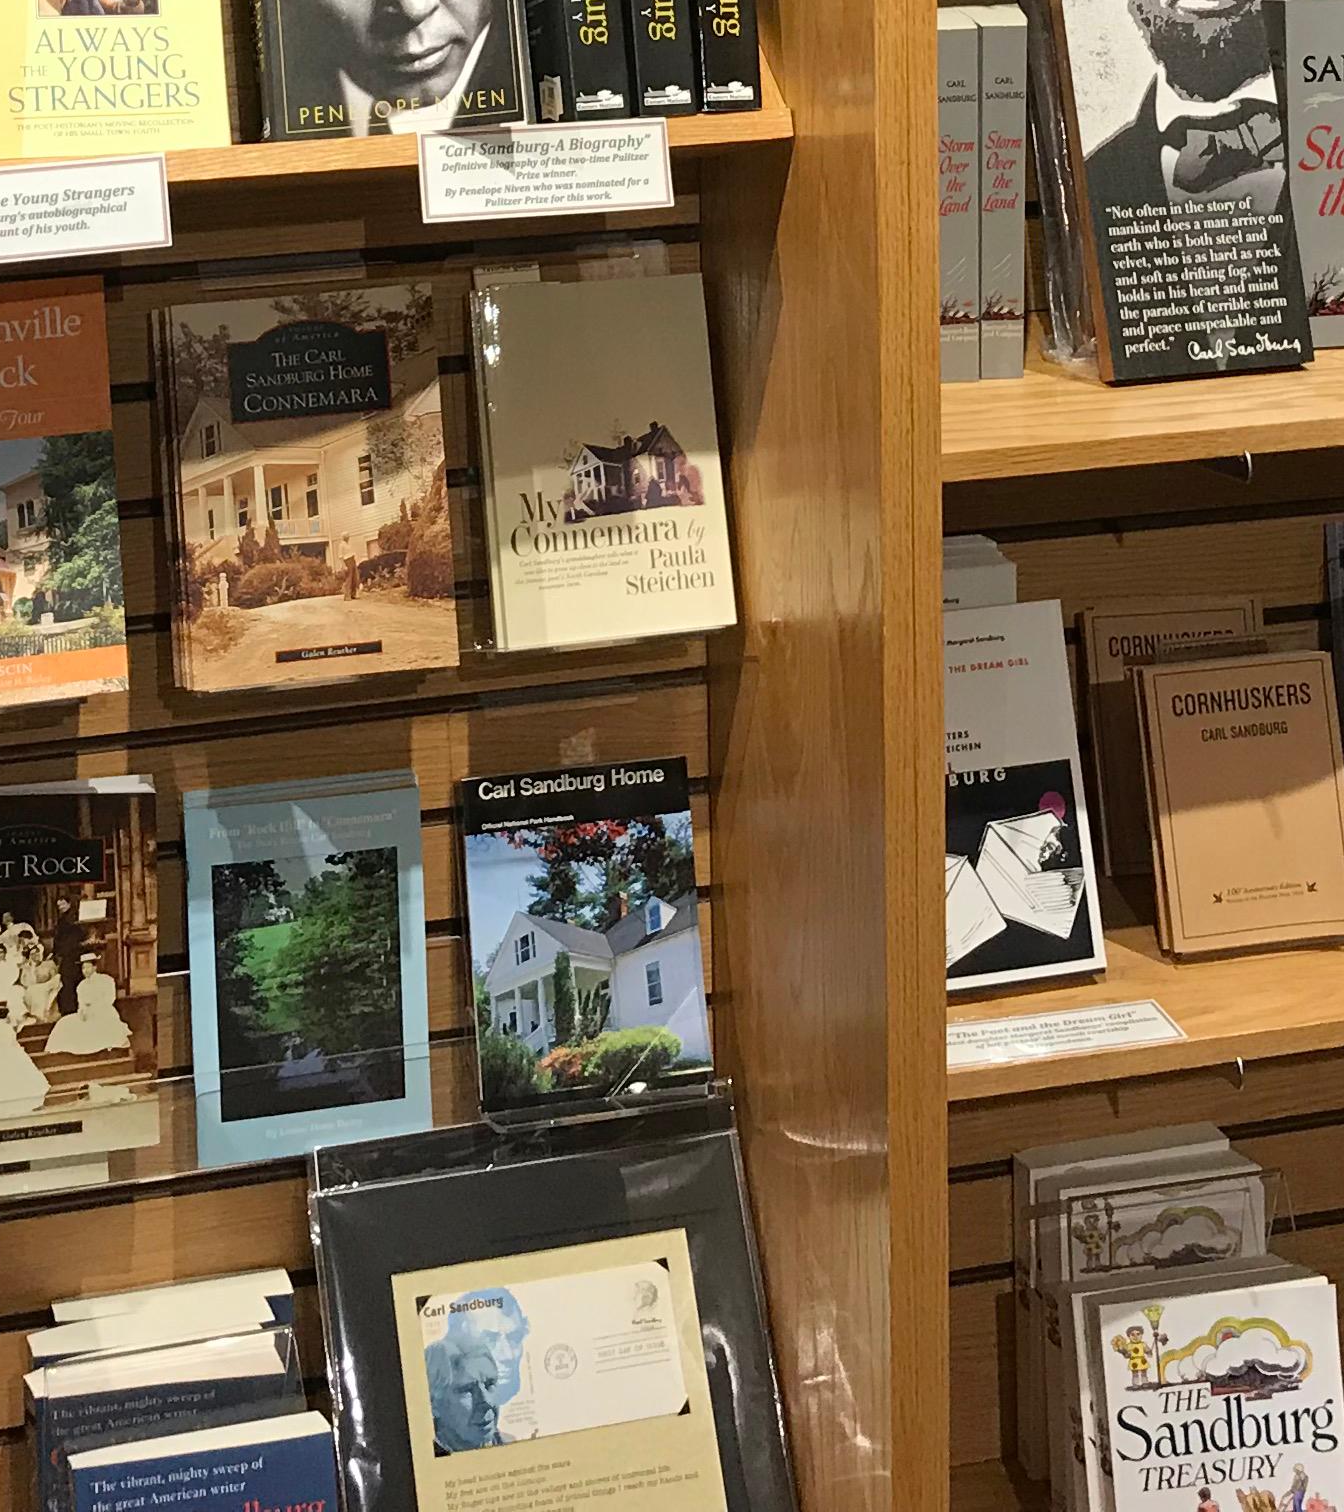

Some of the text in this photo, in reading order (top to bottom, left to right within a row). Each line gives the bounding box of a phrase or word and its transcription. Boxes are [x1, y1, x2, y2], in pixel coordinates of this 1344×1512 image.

[35, 26, 169, 53] ALWAYS
[21, 54, 187, 83] THE YOUNG
[9, 81, 200, 114] STRANGERS
[13, 192, 59, 207] Young
[63, 186, 135, 202] Strangers
[272, 348, 347, 369] THE CARL
[246, 364, 373, 388] SANDBURG HOME
[244, 388, 379, 414] CONNEMARA
[519, 490, 562, 526] My
[510, 519, 706, 557] Connemara by
[648, 544, 706, 568] Paula
[625, 568, 715, 597] Steichen
[1171, 683, 1312, 717] CORNHUSKERS
[478, 767, 664, 801] Carl Sandburg Home
[21, 853, 90, 876] ROCK
[1158, 1388, 1211, 1412] THE
[1116, 1394, 1338, 1463] Sandburg
[1138, 1452, 1284, 1492] TREASURY
